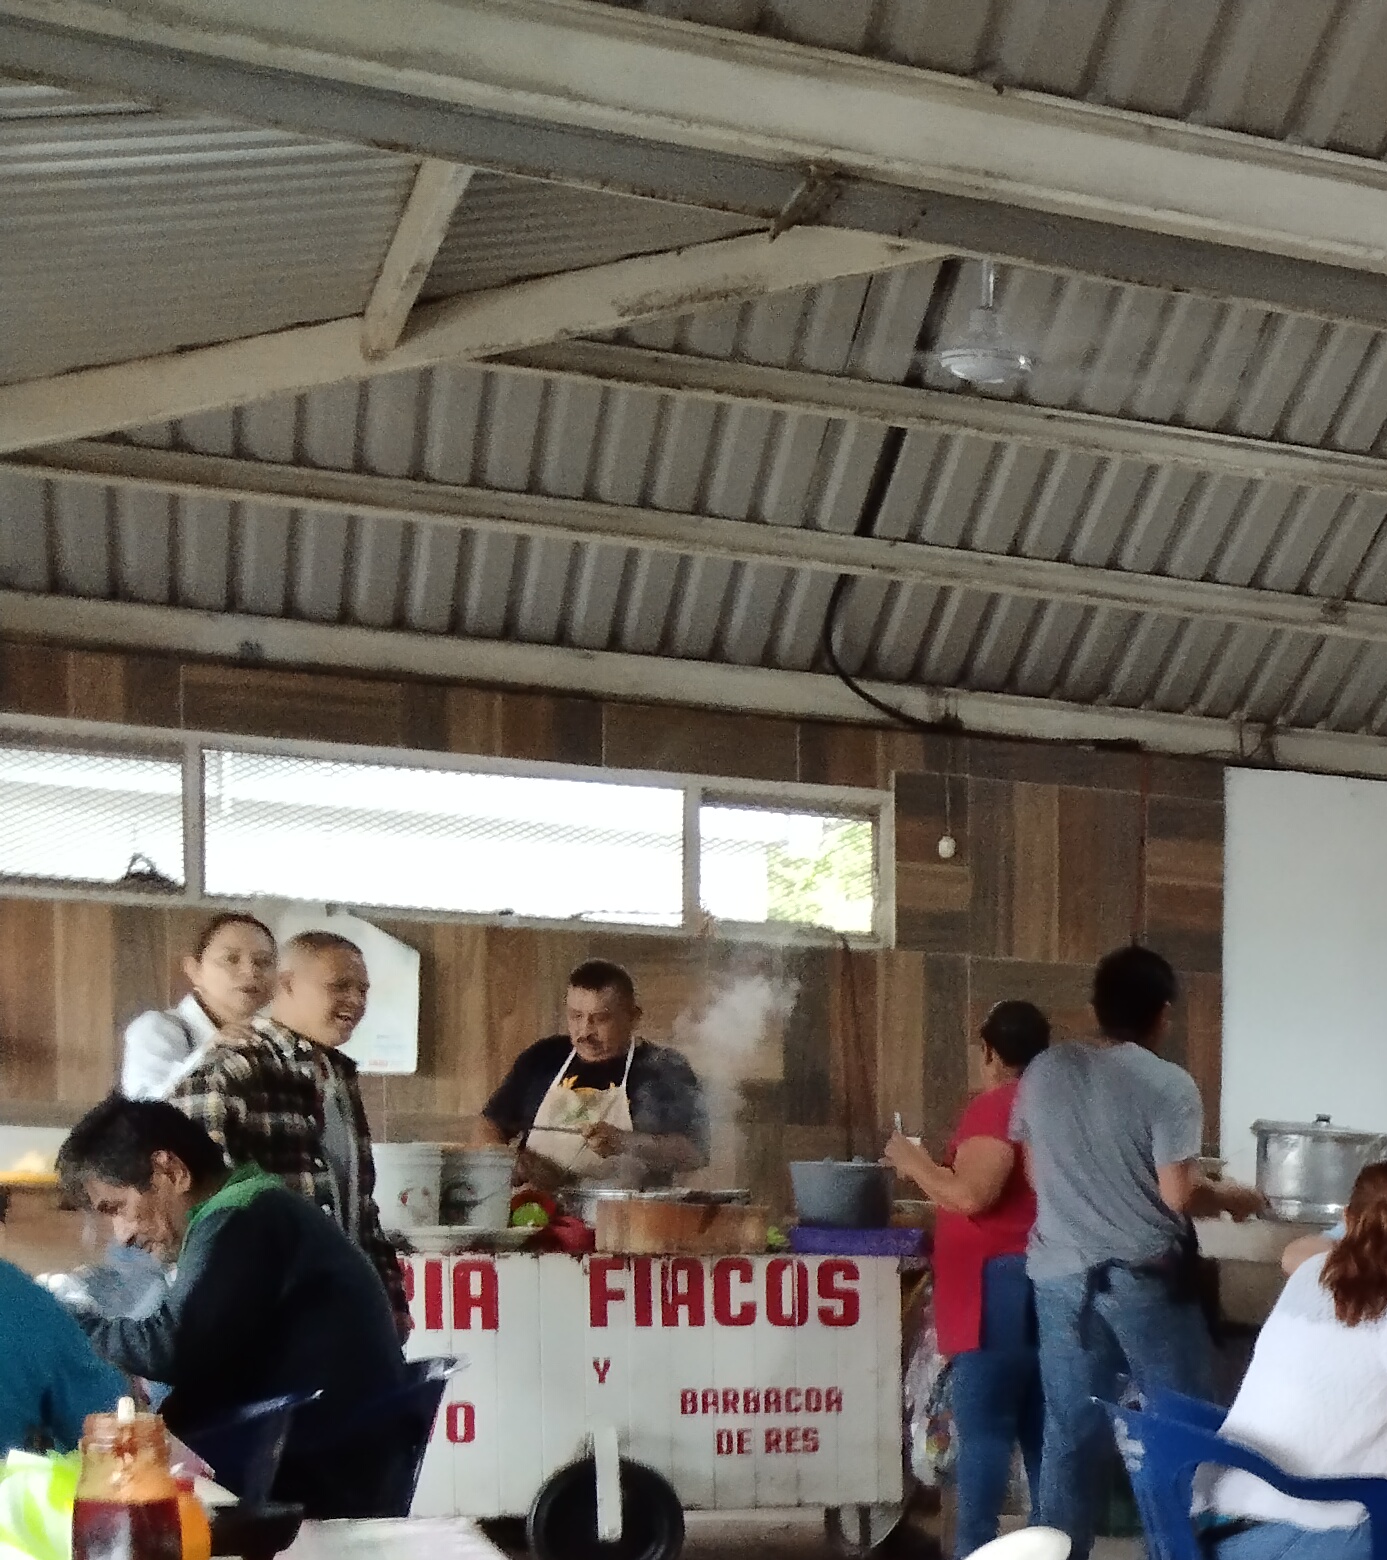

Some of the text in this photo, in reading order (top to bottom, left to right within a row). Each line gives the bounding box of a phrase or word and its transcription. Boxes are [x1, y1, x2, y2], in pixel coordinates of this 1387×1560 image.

[592, 1357, 611, 1384] Y
[680, 1386, 844, 1415] BARBACOA
[716, 1426, 821, 1456] DE RES
